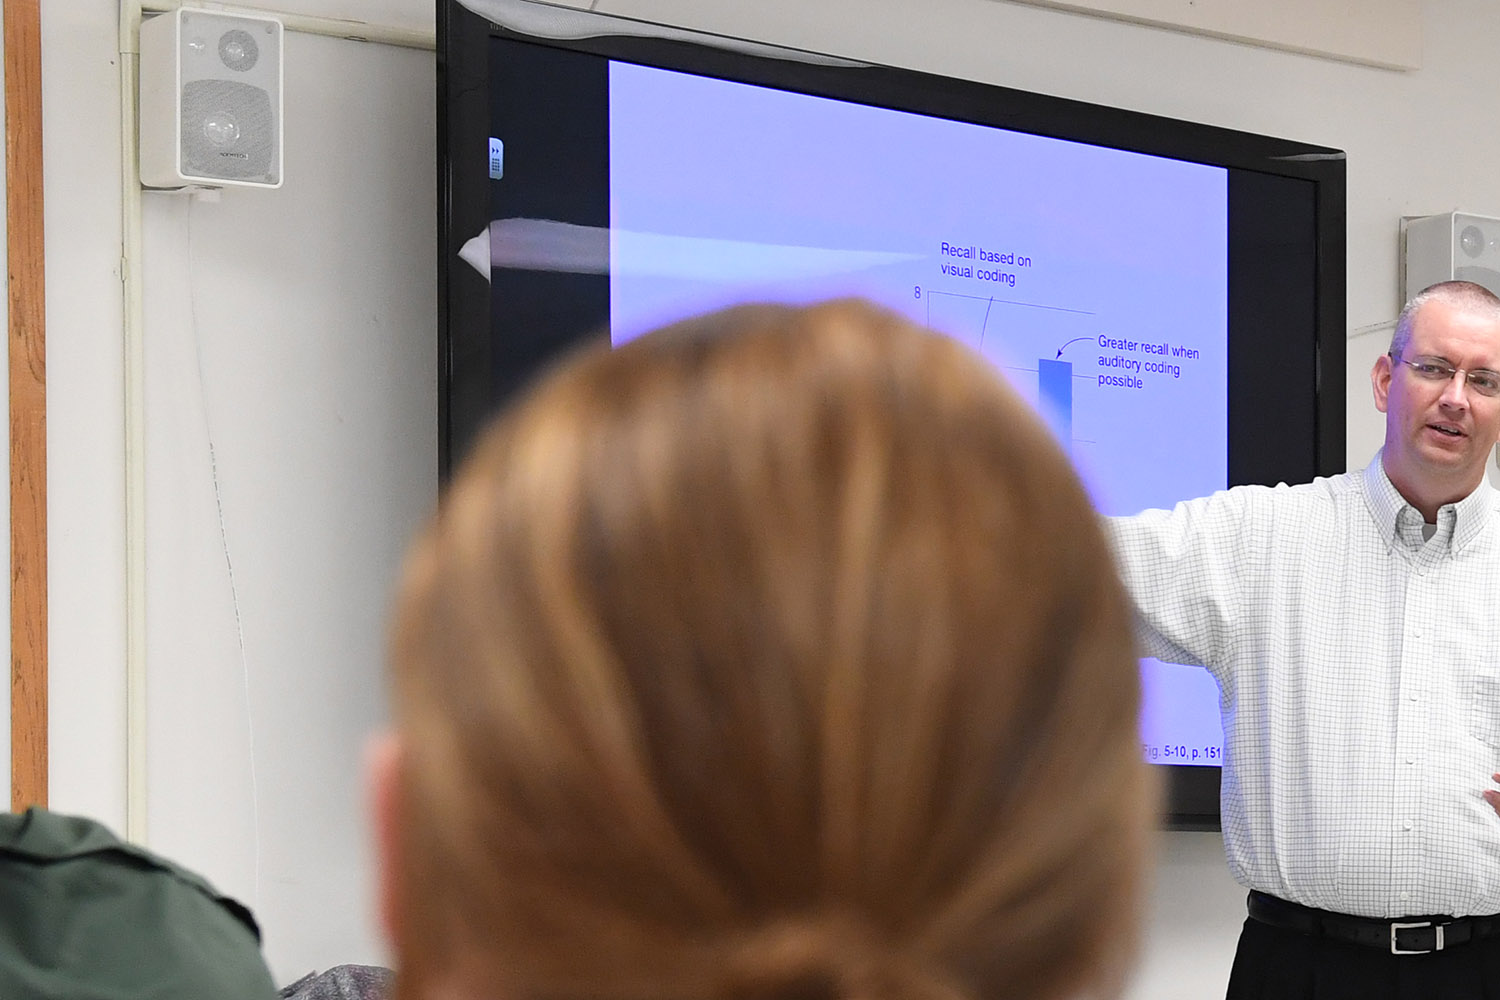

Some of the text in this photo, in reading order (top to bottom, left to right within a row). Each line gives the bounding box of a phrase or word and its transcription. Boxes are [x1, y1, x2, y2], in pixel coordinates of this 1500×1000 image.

[941, 242, 1032, 268] Recall based on
[941, 262, 1016, 288] visual coding
[914, 286, 921, 299] 8
[1098, 334, 1200, 360] Greater recall when
[1098, 355, 1180, 379] auditory coding
[1098, 374, 1143, 389] possible
[1164, 745, 1189, 760] 5-10,
[1191, 748, 1201, 761] p.
[1204, 746, 1221, 759] 151
